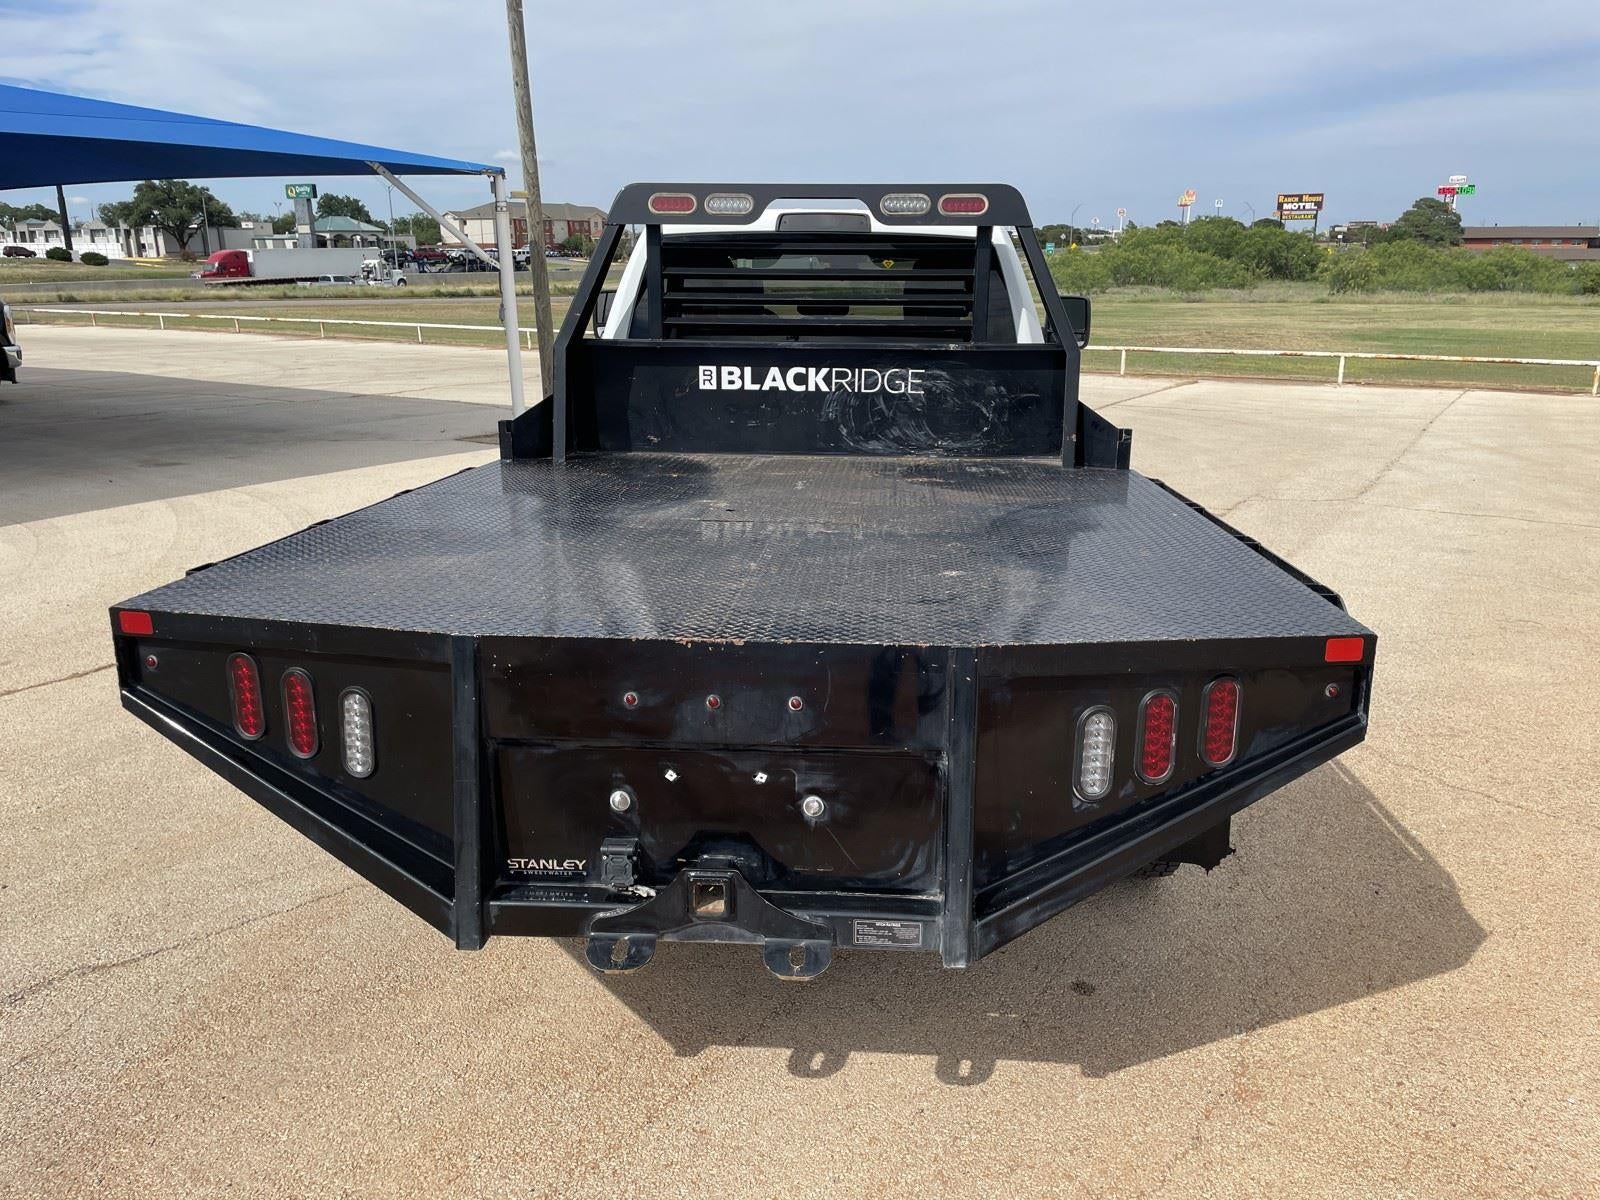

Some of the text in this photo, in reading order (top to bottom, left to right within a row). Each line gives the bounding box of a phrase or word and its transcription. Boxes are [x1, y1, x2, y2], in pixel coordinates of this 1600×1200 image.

[296, 185, 310, 193] Quality
[721, 366, 925, 394] BLACKRIDGE
[507, 858, 587, 870] STANLEY
